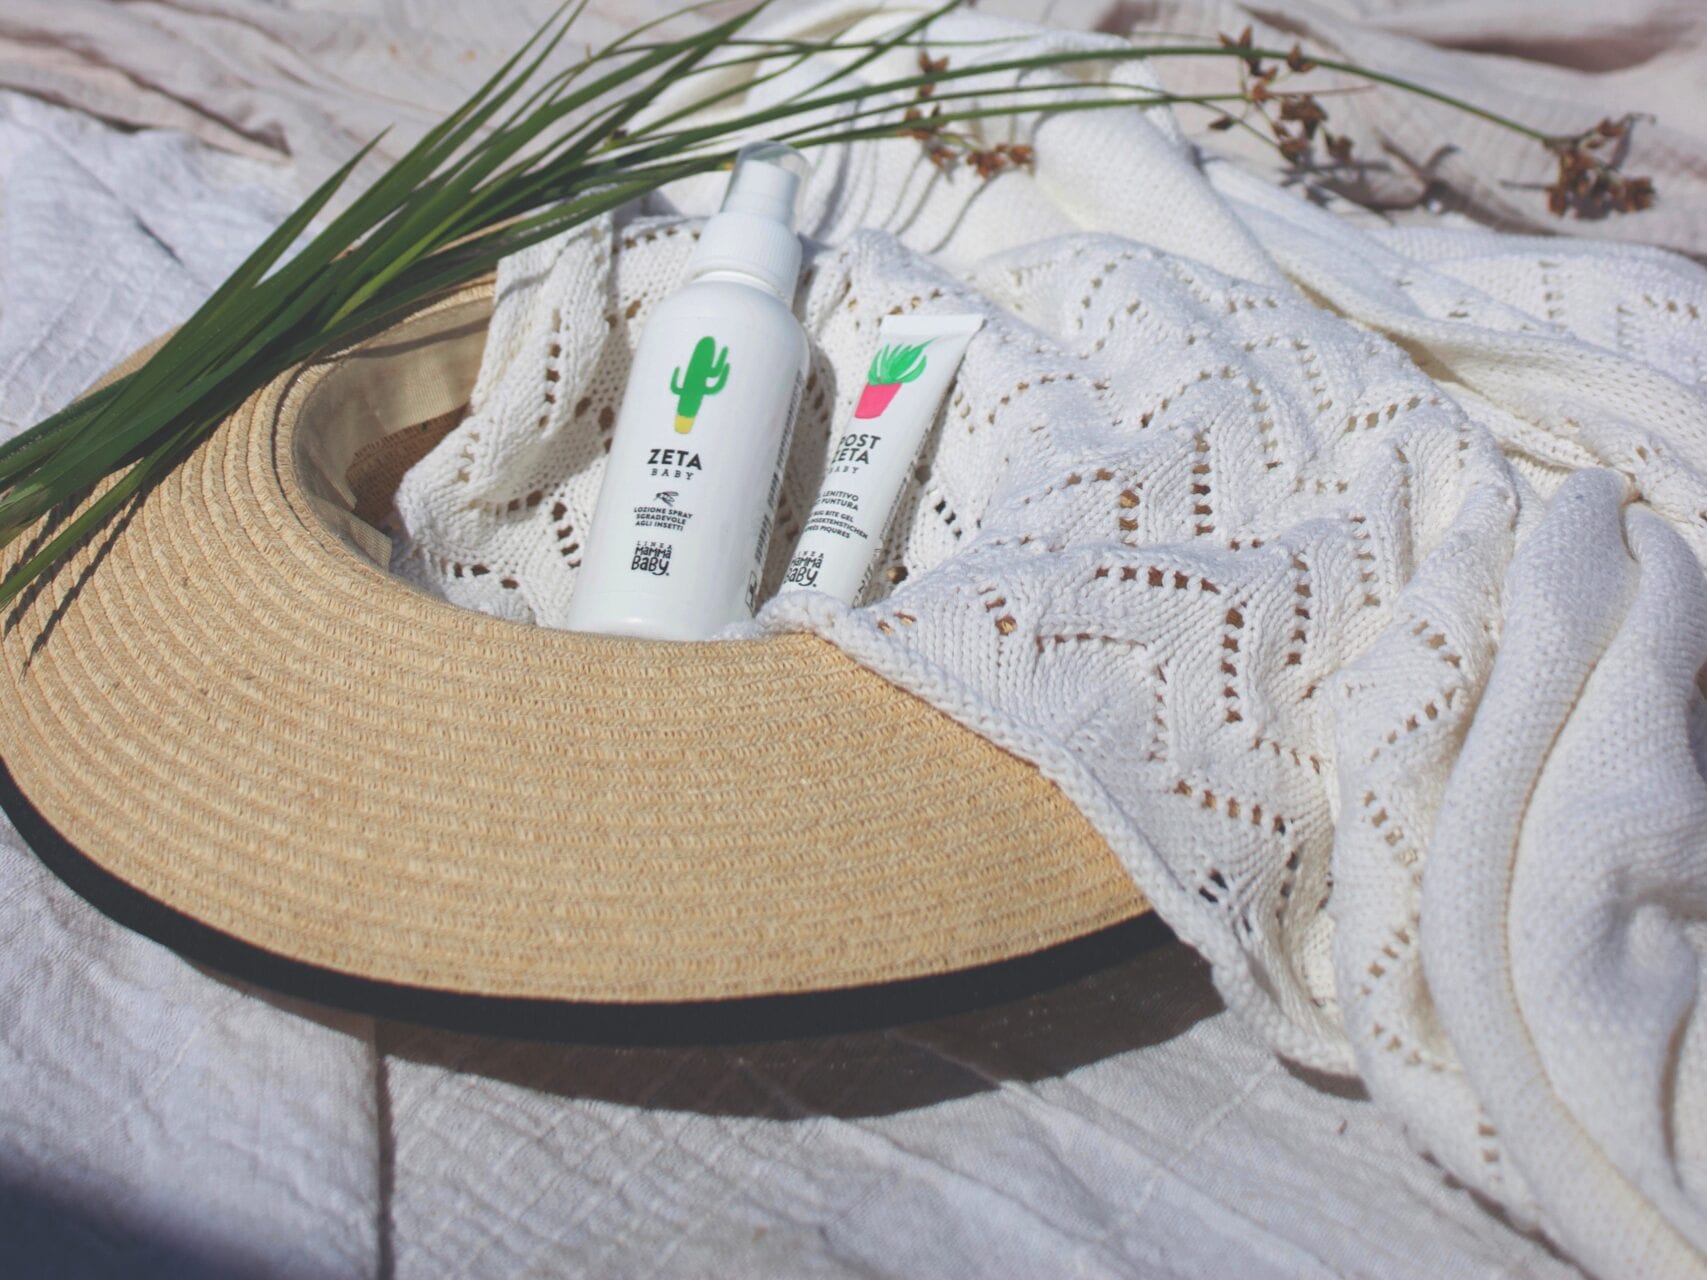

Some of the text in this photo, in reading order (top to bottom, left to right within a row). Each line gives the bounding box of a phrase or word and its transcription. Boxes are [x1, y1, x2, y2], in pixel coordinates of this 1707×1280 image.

[647, 448, 702, 470] ZETA
[650, 468, 694, 480] BABY
[822, 490, 859, 502] LENITIVO
[821, 498, 859, 510] PUNTURA
[633, 506, 693, 520] LOZIONE SPRAY
[840, 513, 854, 523] GEL
[636, 513, 687, 526] SGRADEVOLE
[654, 521, 684, 531] INSETTI
